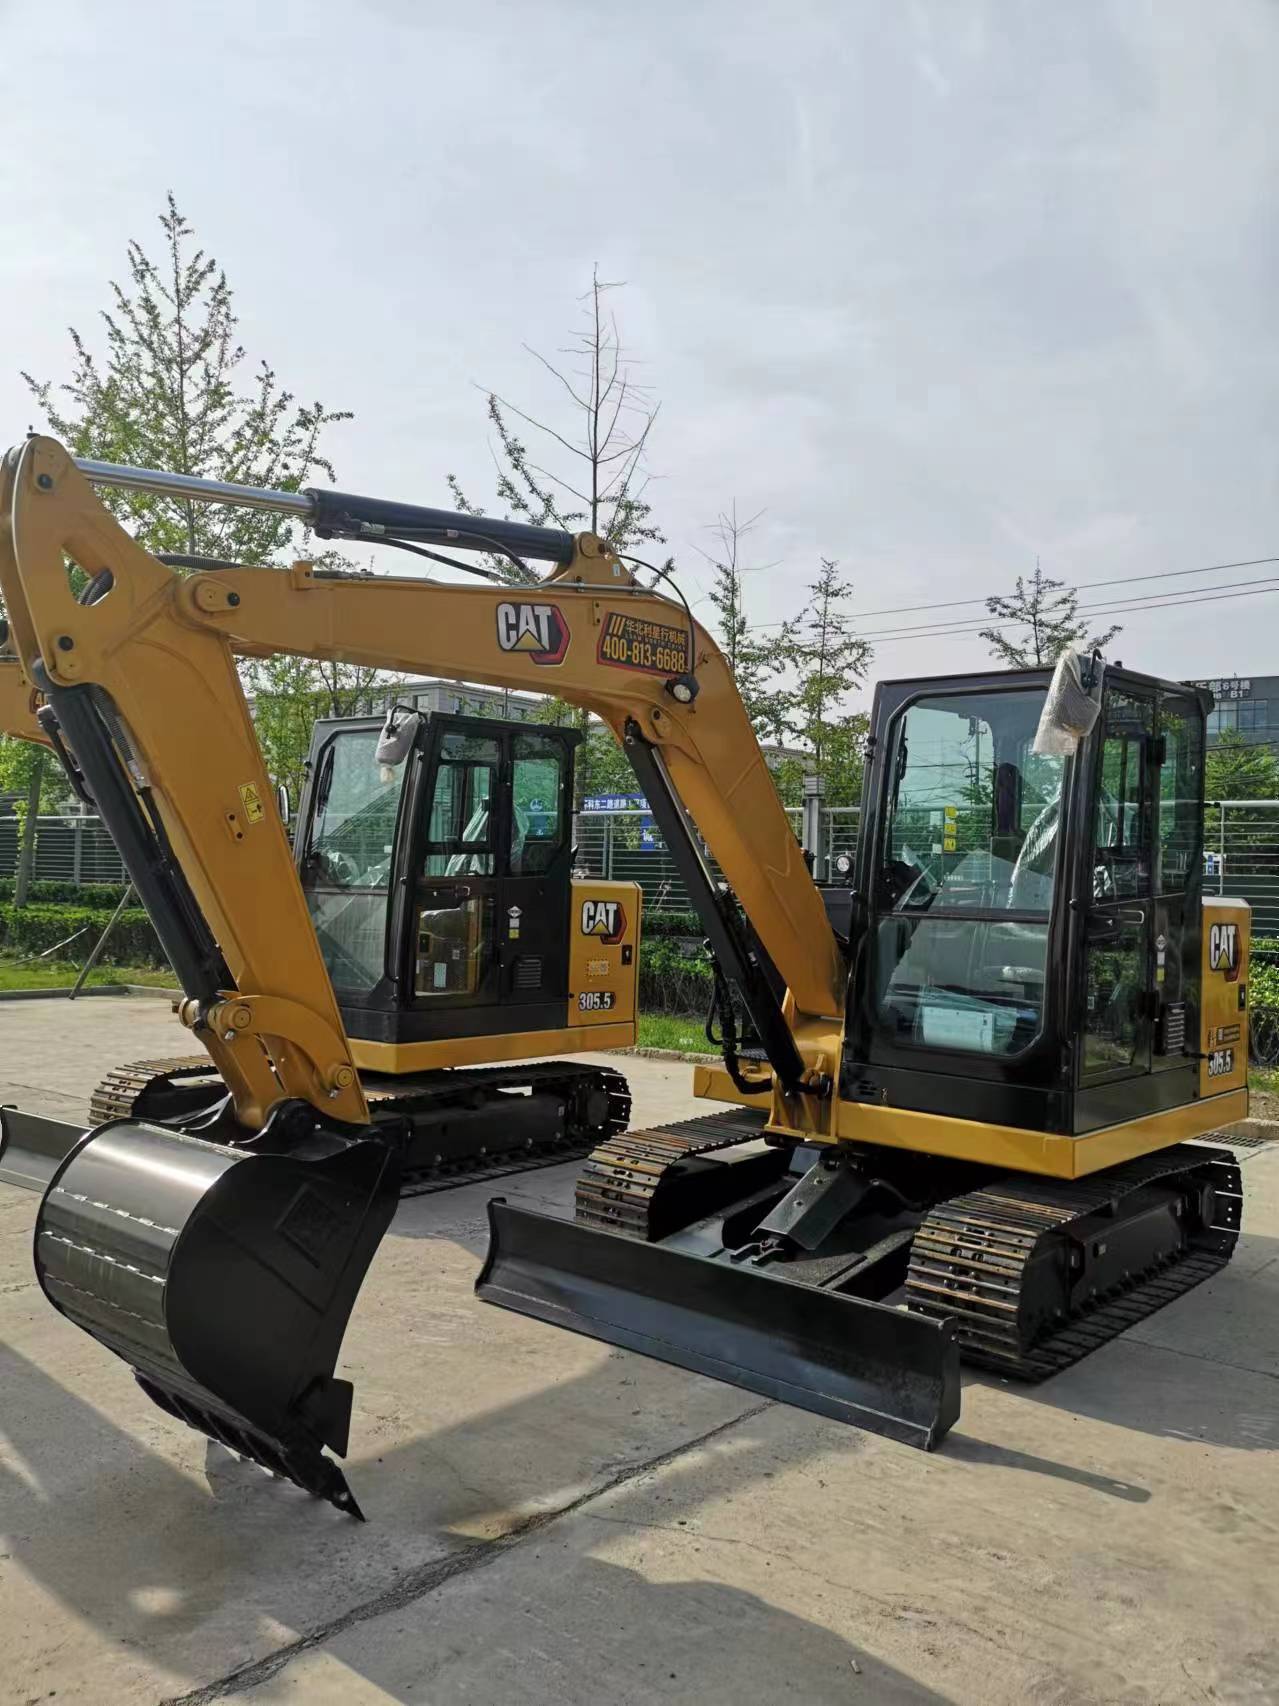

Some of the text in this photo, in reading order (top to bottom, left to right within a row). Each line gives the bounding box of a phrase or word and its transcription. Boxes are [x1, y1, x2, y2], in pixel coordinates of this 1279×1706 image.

[499, 603, 552, 651] CAT
[603, 635, 685, 674] 400-813-6688
[582, 901, 618, 935] CAT
[1210, 924, 1236, 969] CAT
[579, 992, 612, 1011] 305.5
